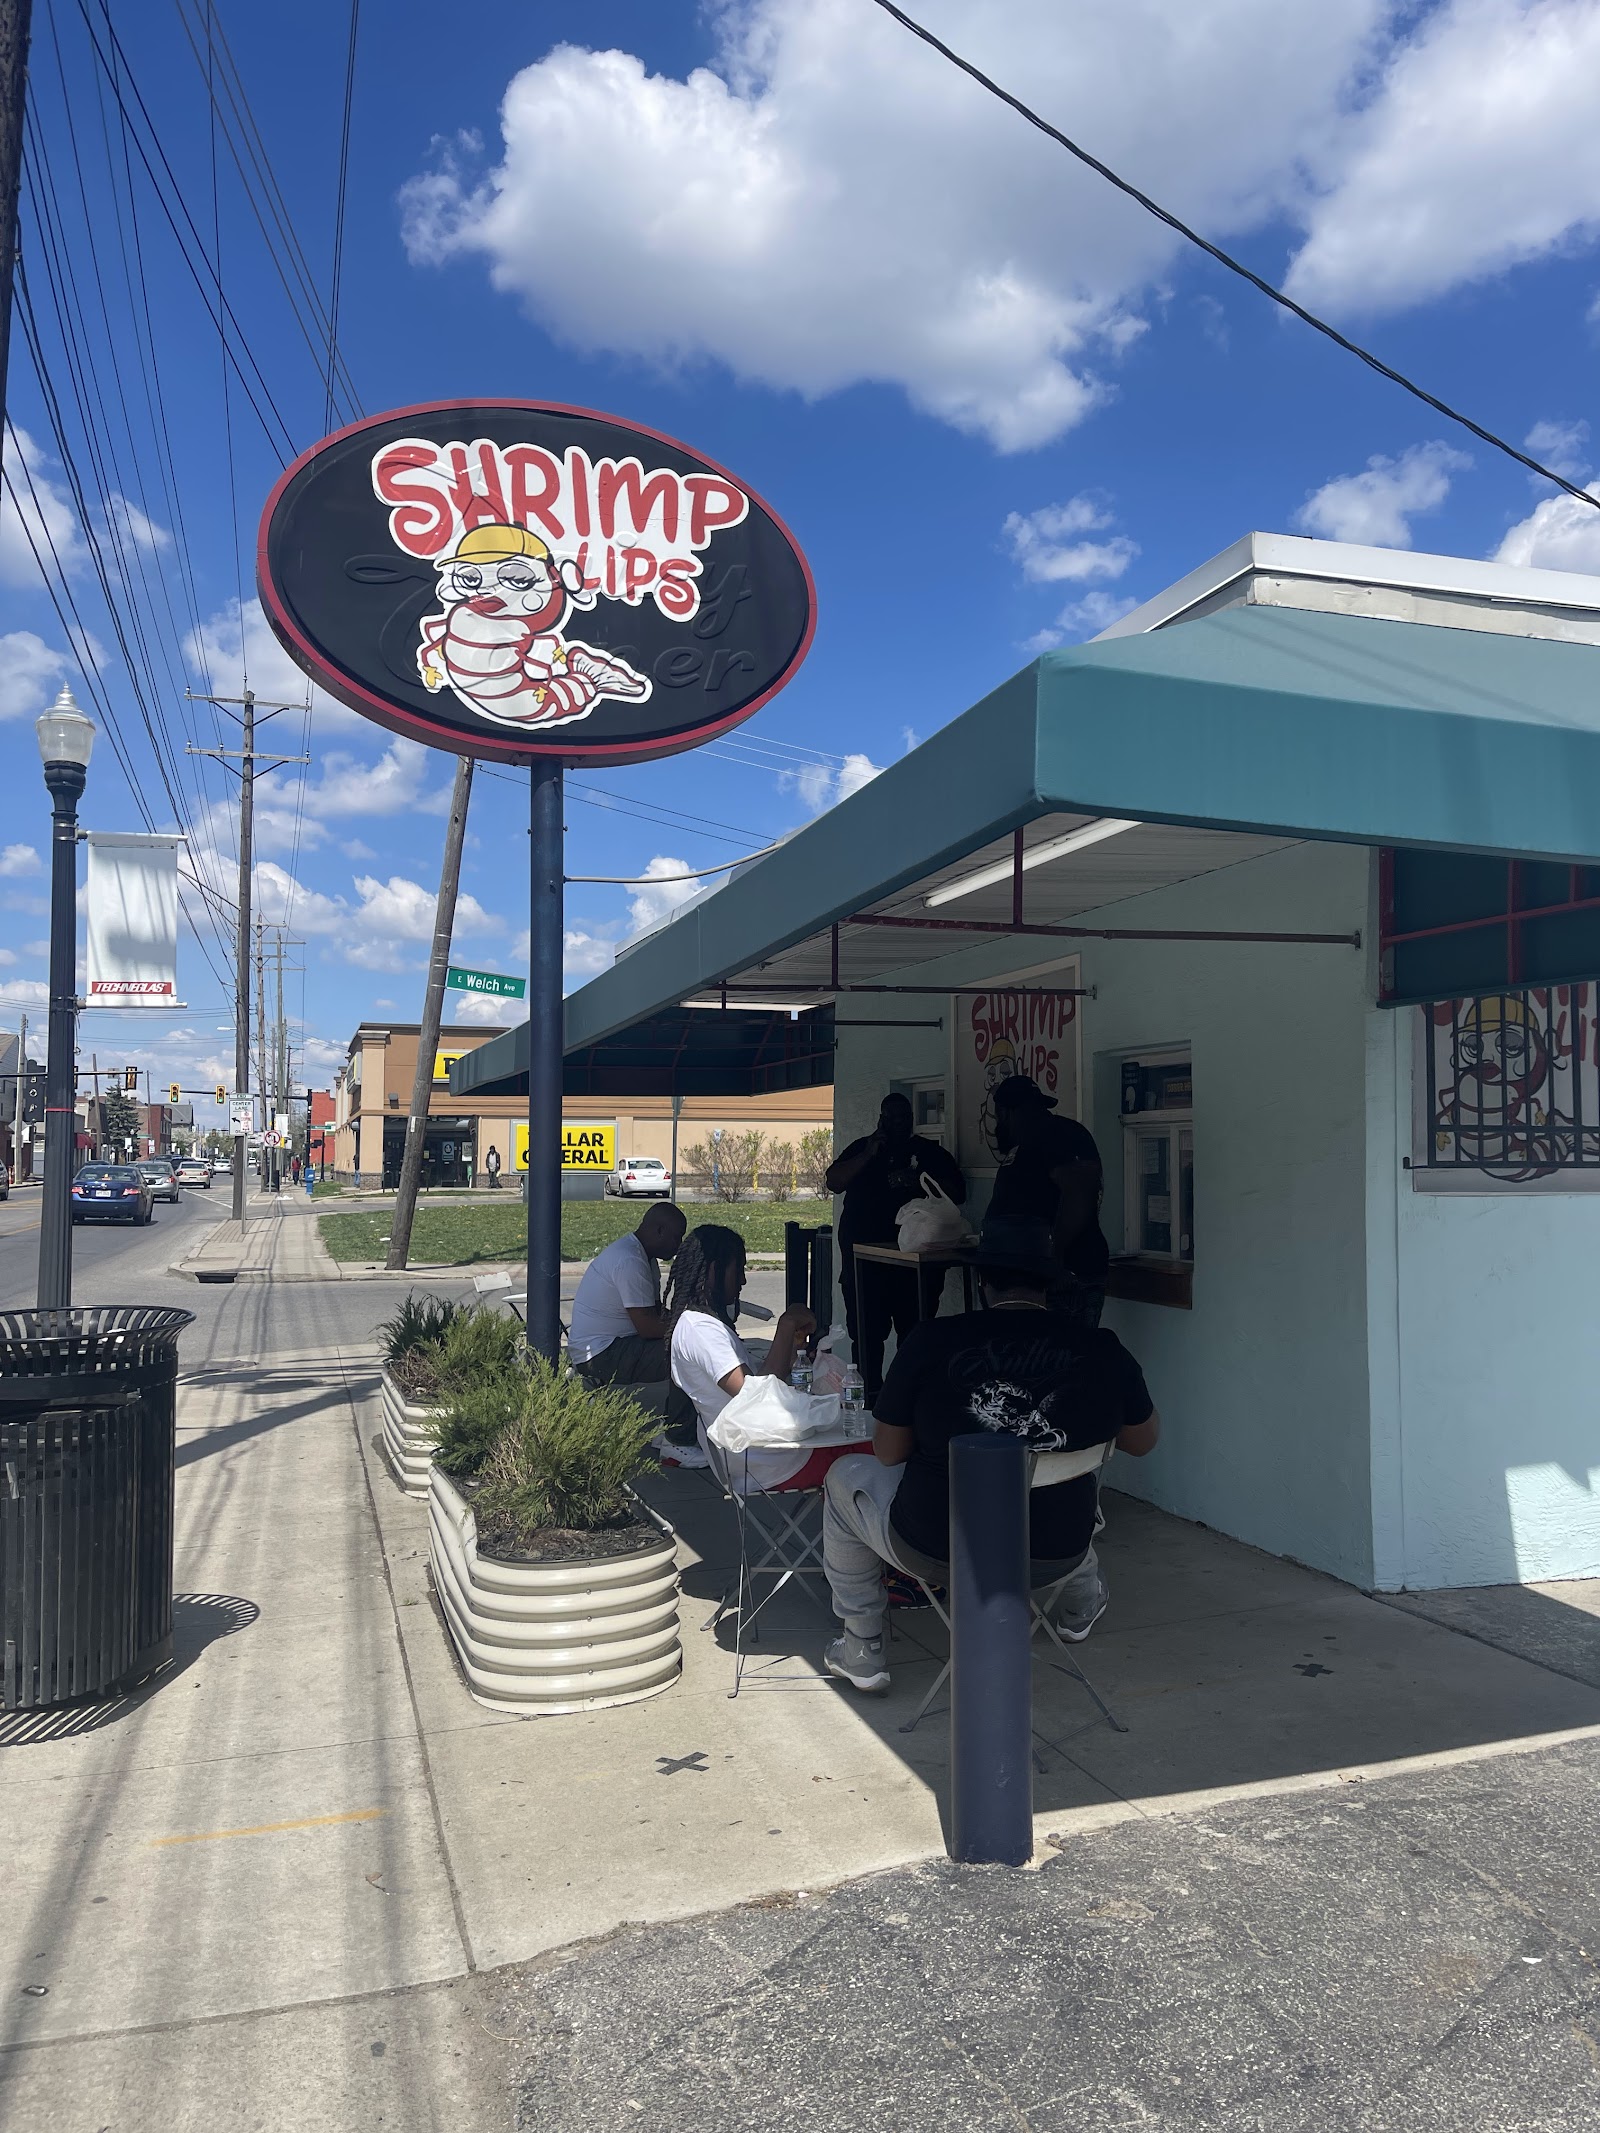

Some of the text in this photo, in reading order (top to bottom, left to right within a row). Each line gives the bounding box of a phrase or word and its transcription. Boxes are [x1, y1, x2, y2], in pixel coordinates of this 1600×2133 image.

[376, 443, 746, 555] SHRIMP
[573, 541, 698, 615] LIPS
[457, 974, 516, 992] E Welch Ave
[971, 985, 1076, 1063] SHRIMP
[1020, 1044, 1060, 1093] LIPS
[528, 1132, 604, 1147] LAR
